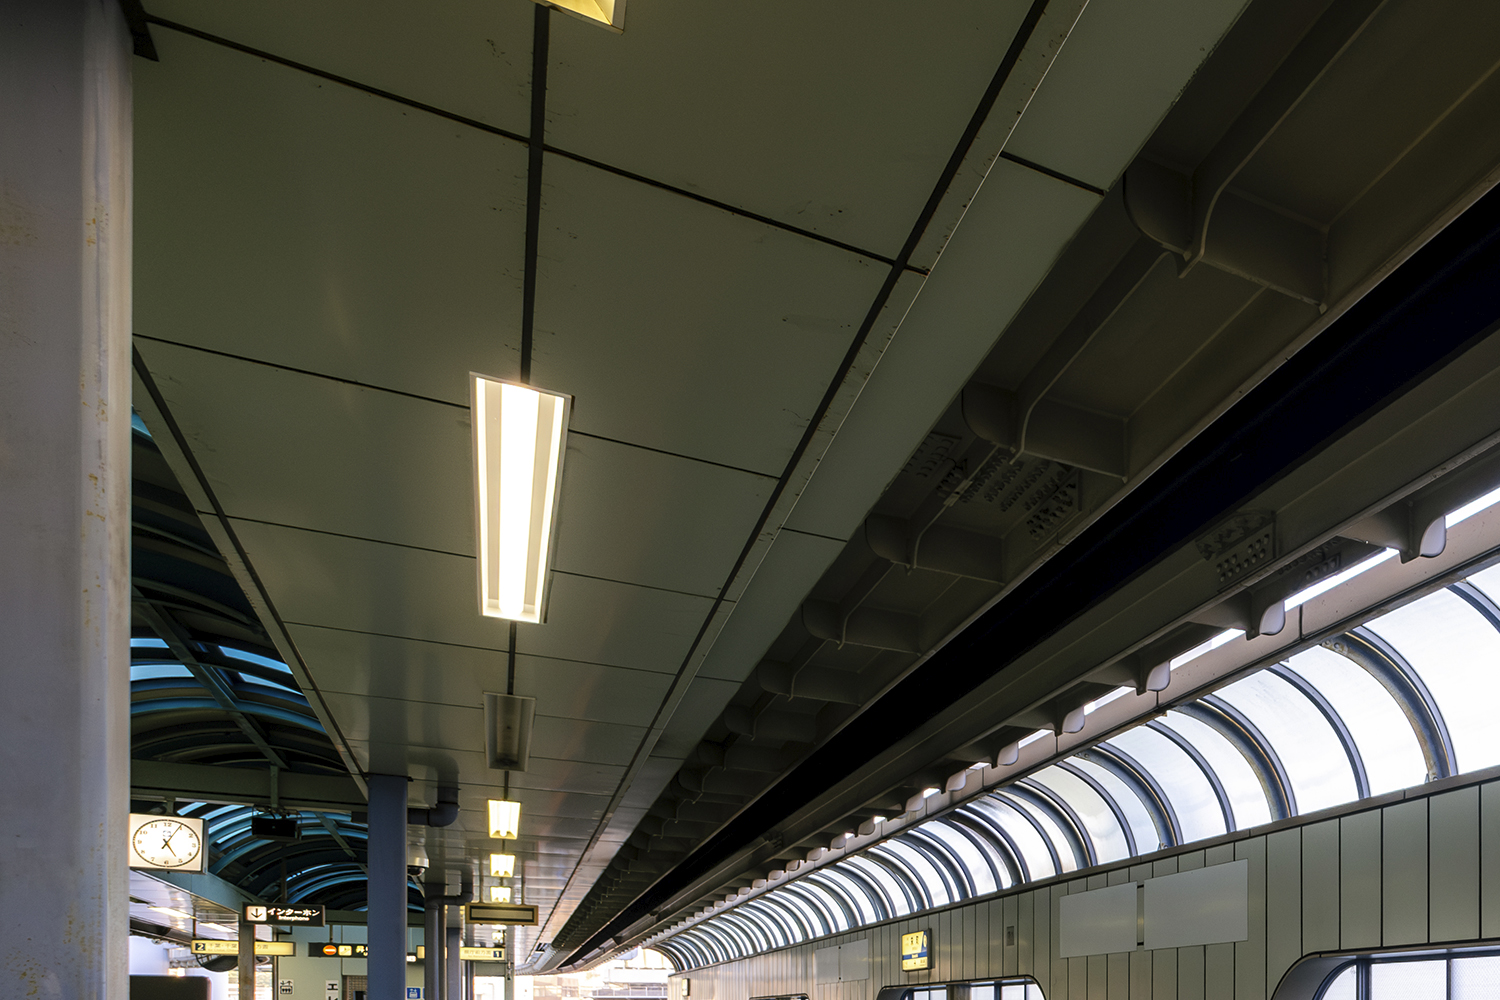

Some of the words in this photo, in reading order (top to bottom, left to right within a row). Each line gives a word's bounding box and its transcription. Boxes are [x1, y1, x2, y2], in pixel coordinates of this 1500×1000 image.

[267, 907, 320, 917] インターホン
